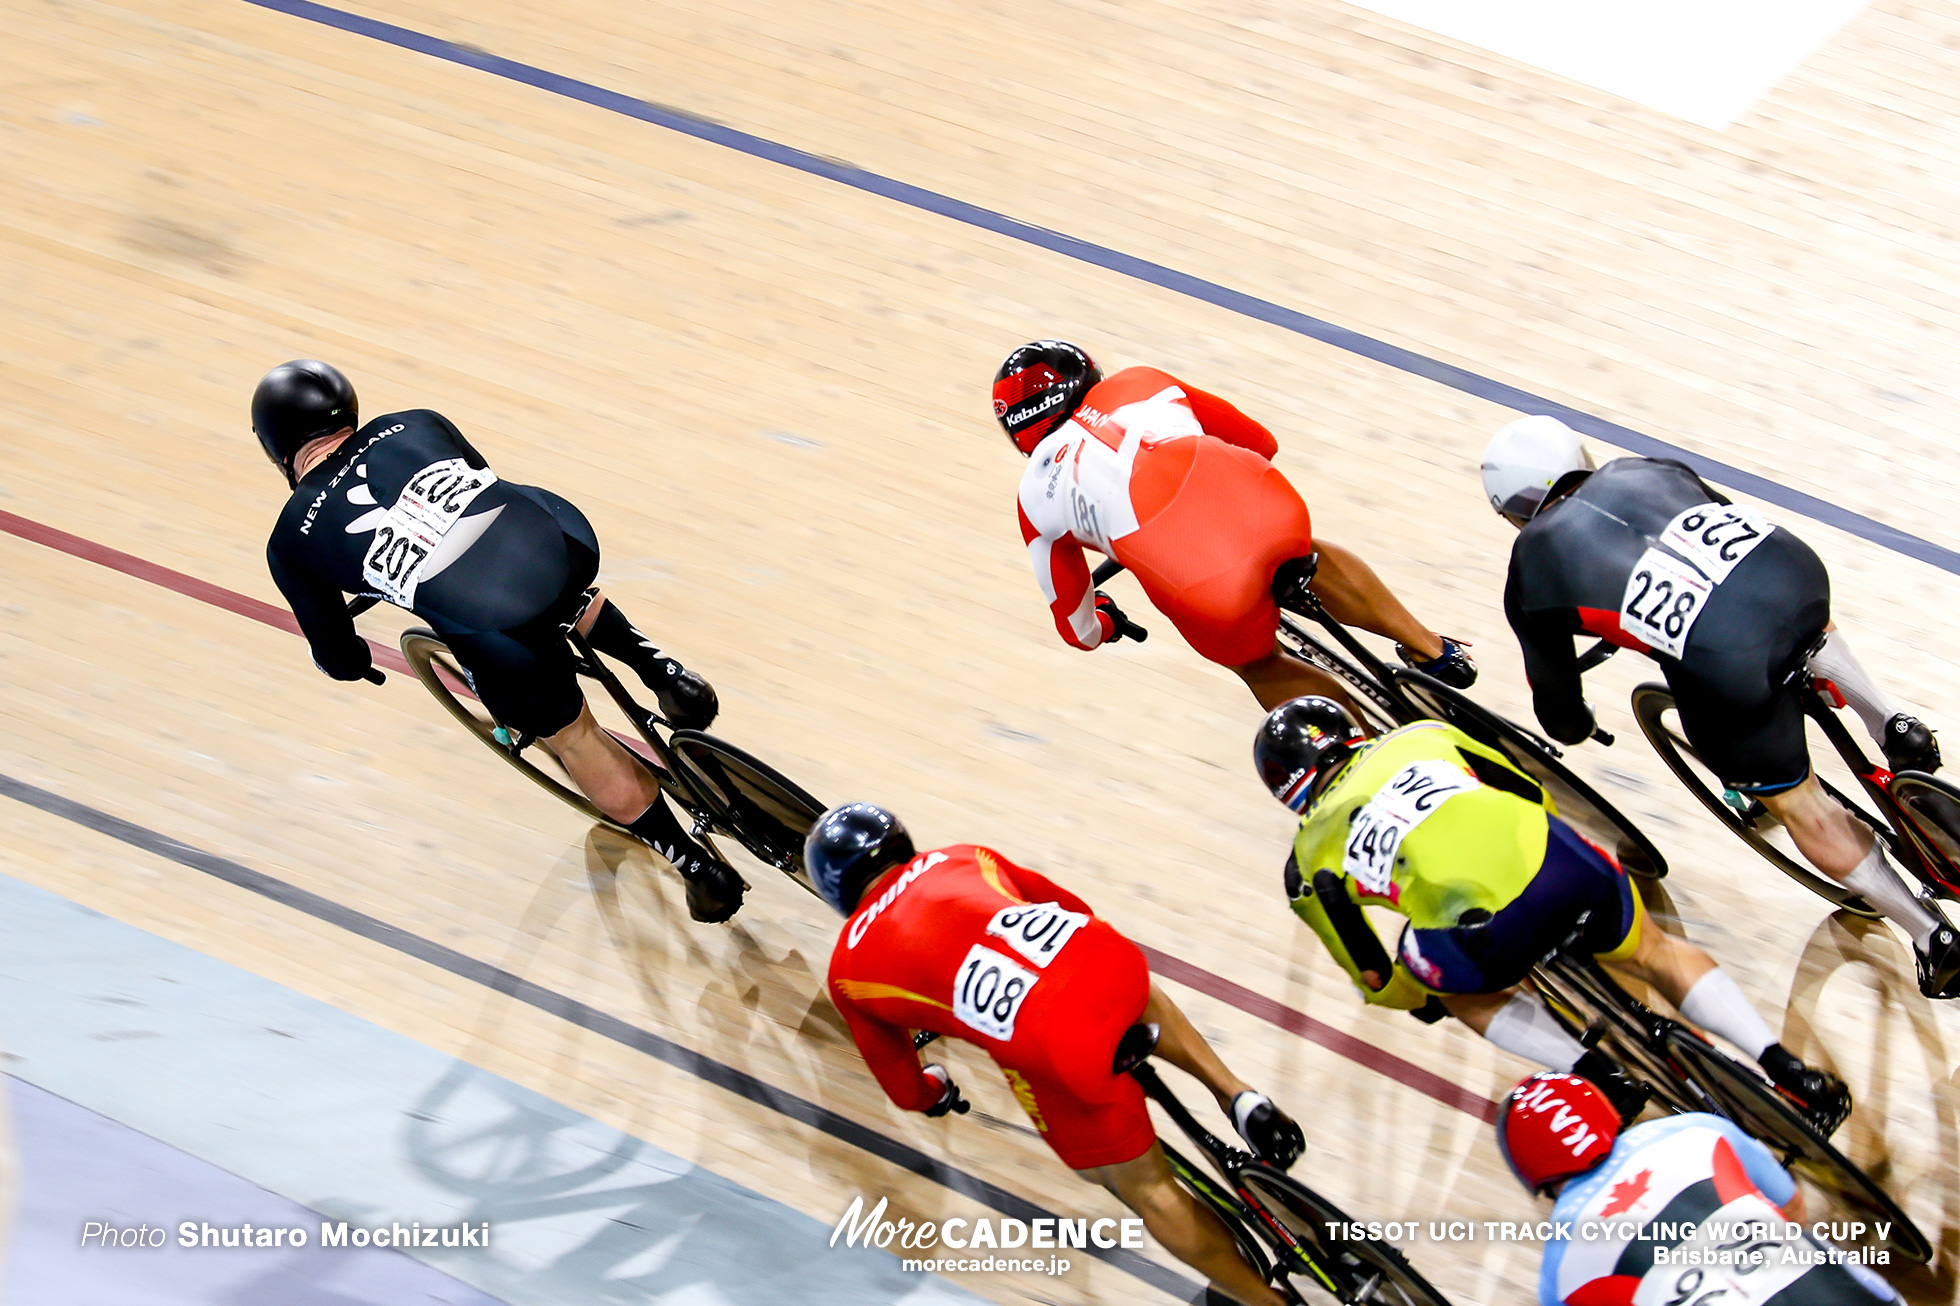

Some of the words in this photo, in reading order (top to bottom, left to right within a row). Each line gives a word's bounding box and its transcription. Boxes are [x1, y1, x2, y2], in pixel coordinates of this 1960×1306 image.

[1006, 392, 1065, 427] Kabuto
[1075, 404, 1110, 428] JAPAN
[300, 490, 328, 535] NEW
[328, 423, 406, 489] ZEALAND
[1071, 487, 1103, 543] 181
[368, 526, 429, 589] 207
[1626, 570, 1696, 639] 228
[847, 851, 950, 950] CHINA
[962, 959, 1024, 1023] 108
[1522, 1081, 1598, 1157] KASK
